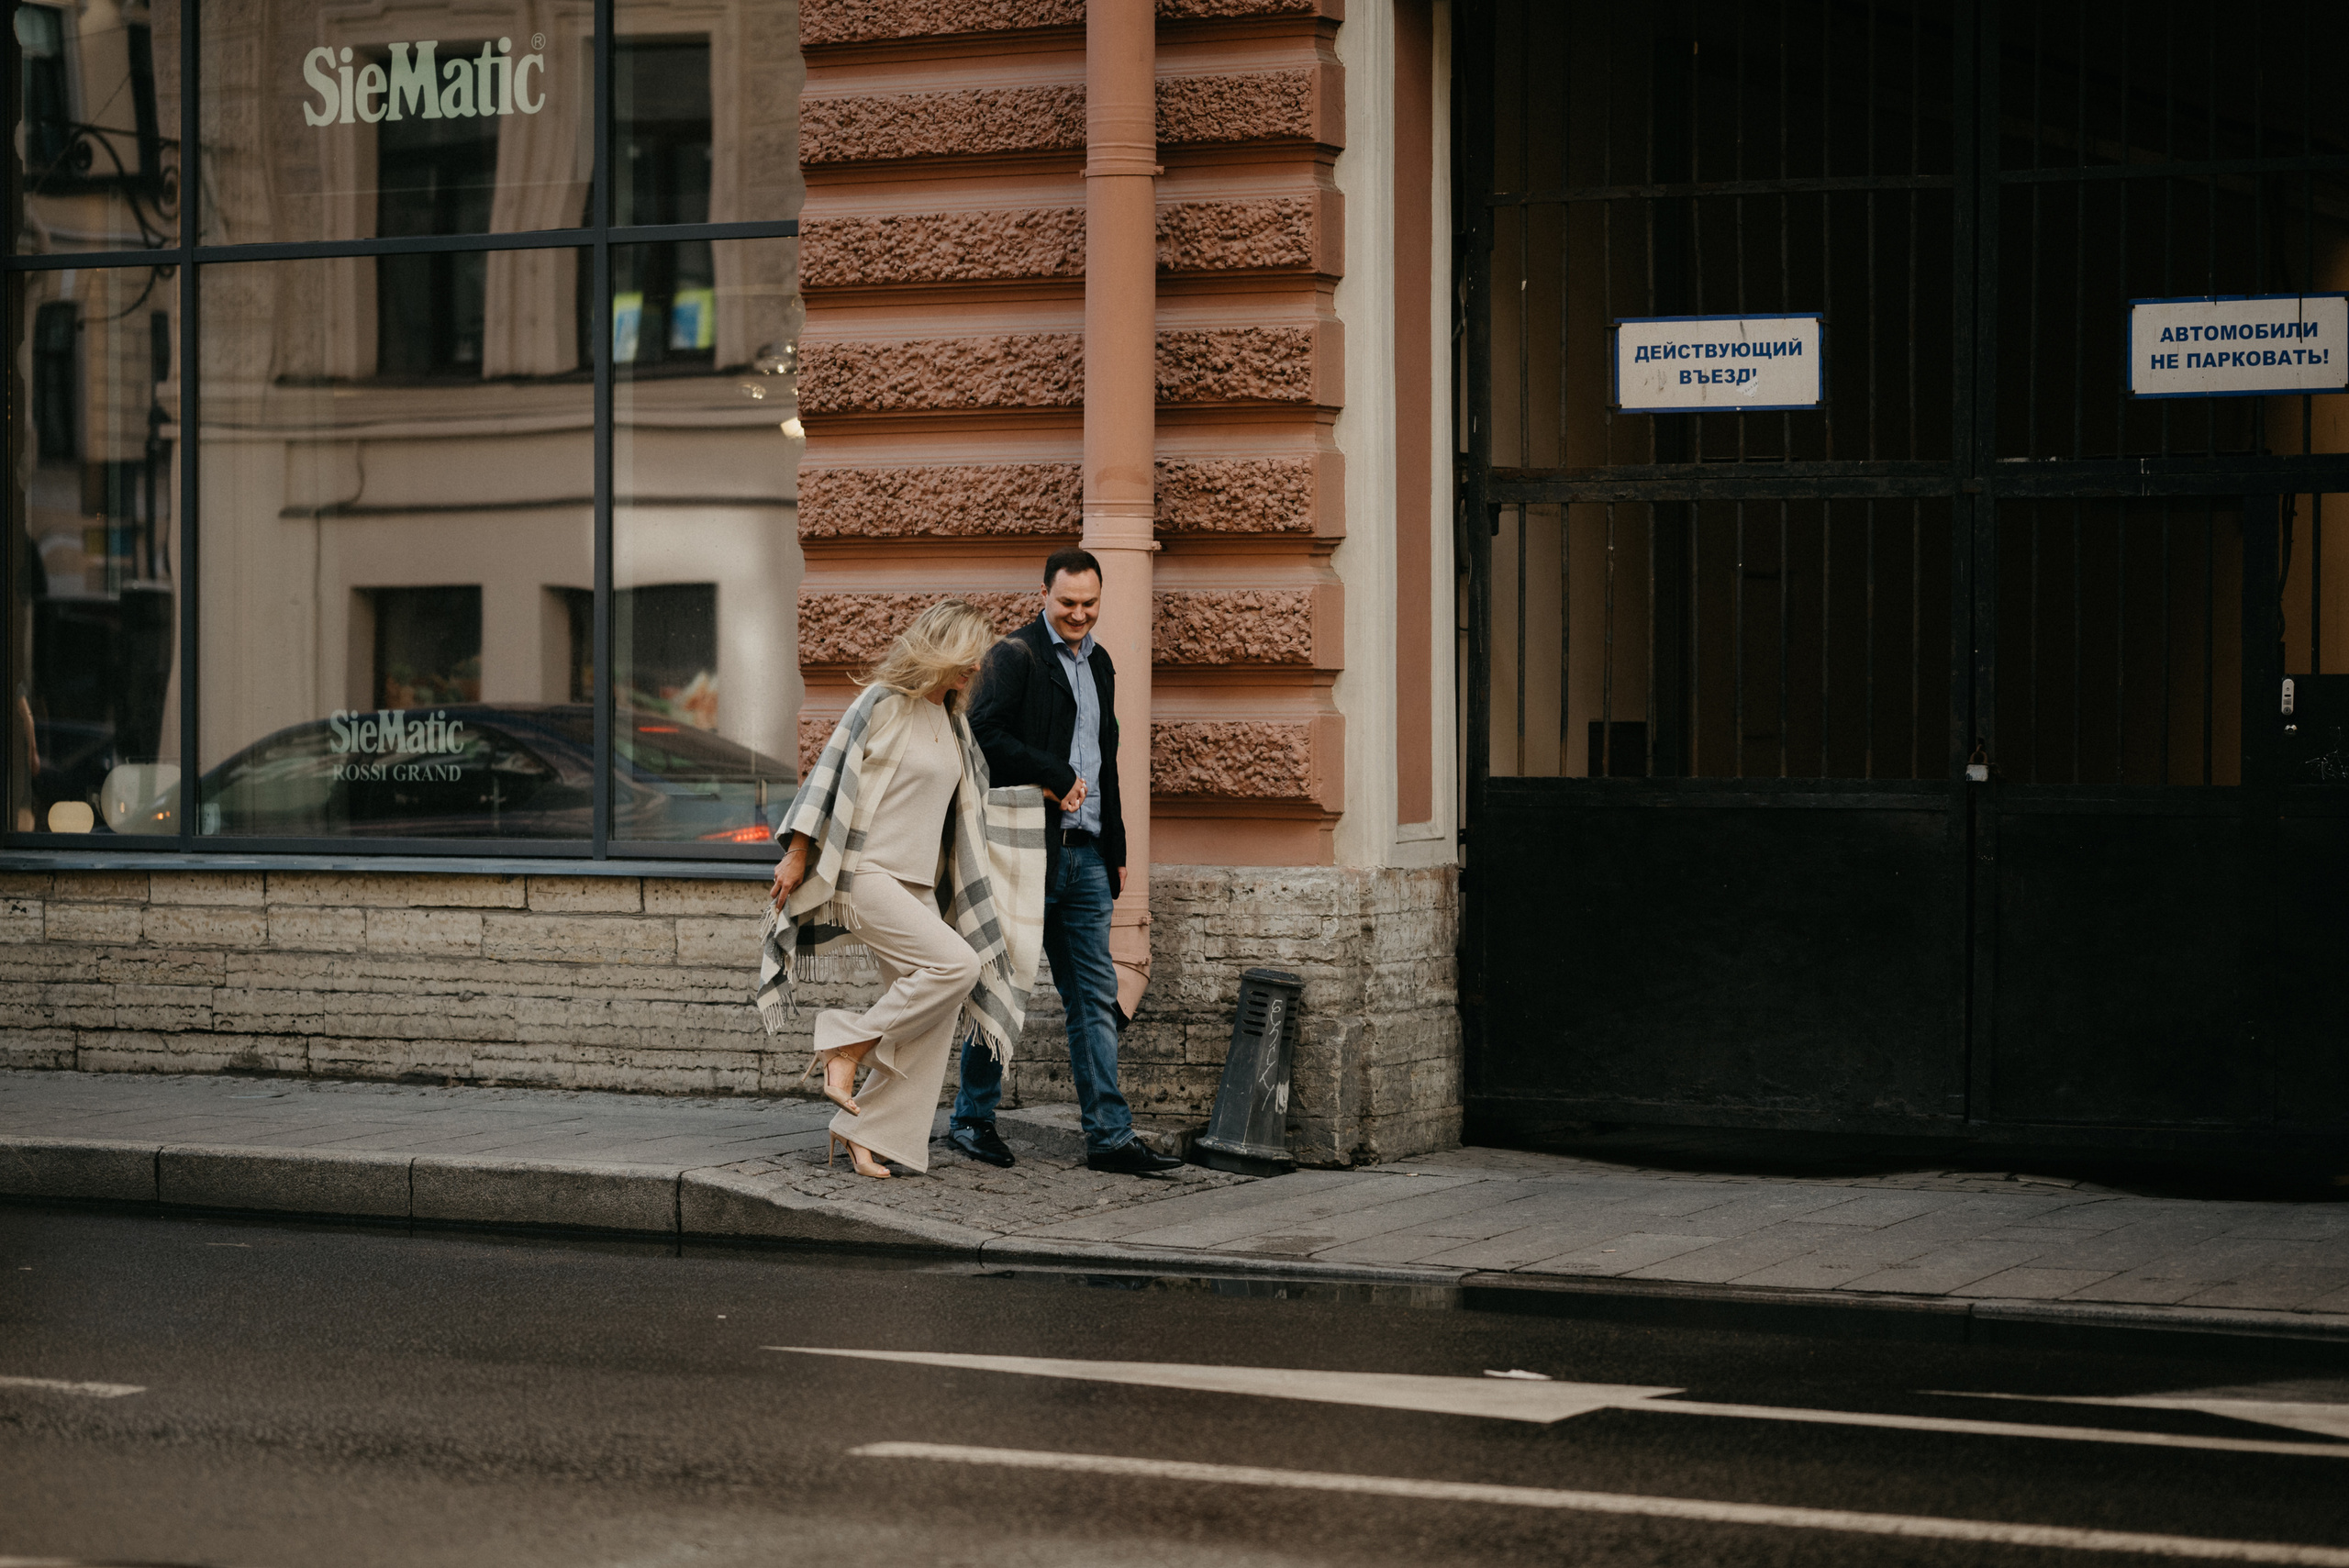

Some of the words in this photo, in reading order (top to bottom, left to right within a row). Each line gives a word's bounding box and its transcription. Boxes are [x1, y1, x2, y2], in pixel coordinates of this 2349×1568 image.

[2159, 321, 2319, 343] АВТОМОБИЛИ
[1634, 337, 1803, 363] ДЕЙСТВУЮЩИЙ
[2151, 353, 2179, 370] НЕ
[2187, 349, 2329, 369] ПАРКОВАТЬ!
[329, 708, 464, 754] SieMatic
[333, 763, 386, 781] ROSSI
[393, 763, 462, 782] GRAND
